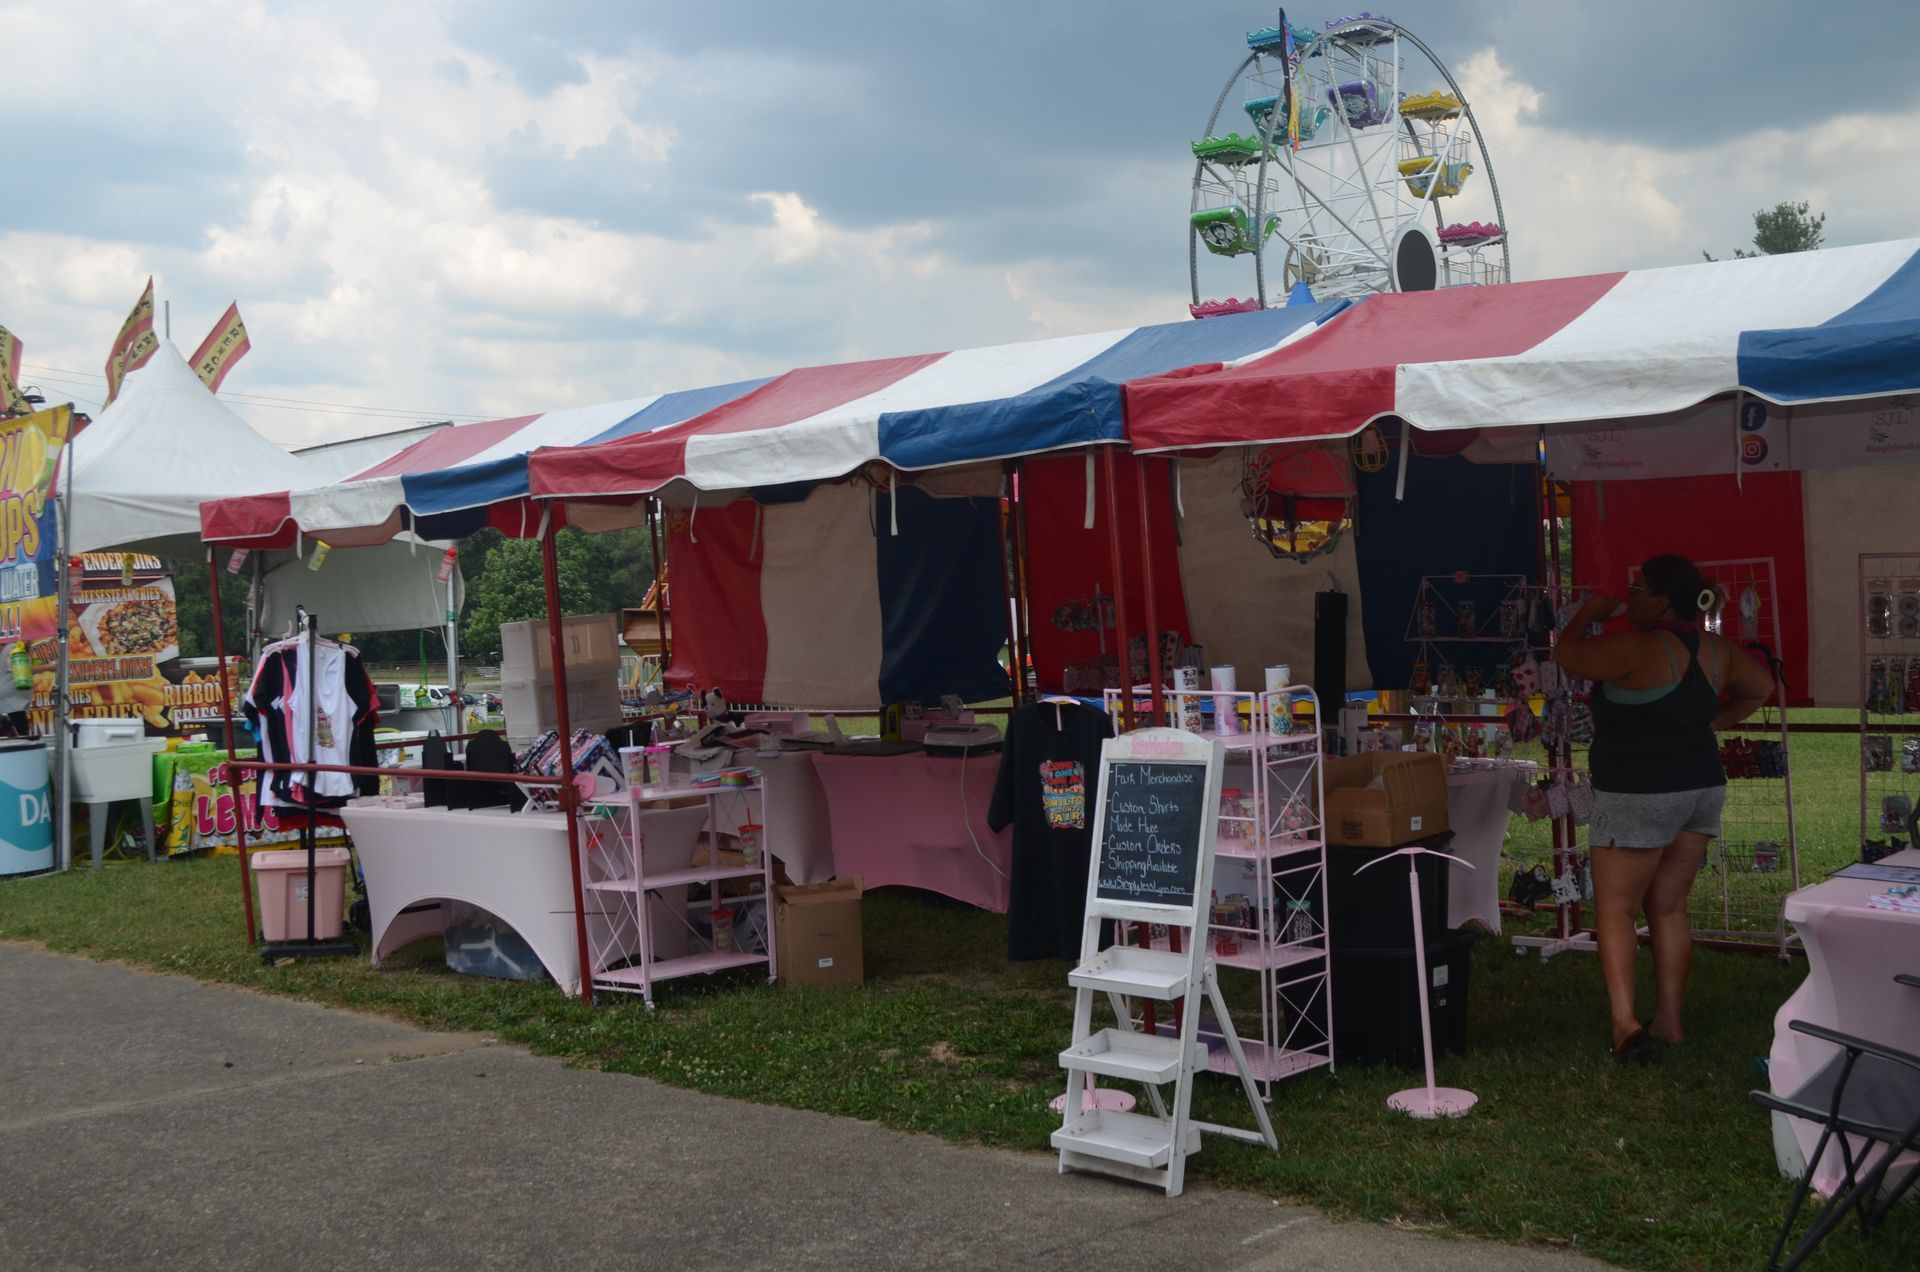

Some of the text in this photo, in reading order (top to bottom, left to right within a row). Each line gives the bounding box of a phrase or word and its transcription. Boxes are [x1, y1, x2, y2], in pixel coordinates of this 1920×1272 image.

[1875, 411, 1908, 426] SJL
[1588, 429, 1621, 442] SJL
[79, 552, 162, 571] ENDEROINS
[1, 567, 40, 601] WATR
[70, 656, 153, 681] NDERLOINS
[70, 688, 92, 704] RIES
[1140, 765, 1193, 785] Merchandise
[1111, 791, 1179, 814] Custom Shirts
[1110, 814, 1134, 832] Made
[1108, 834, 1143, 851] Custom
[1109, 850, 1178, 878] Shipping Available
